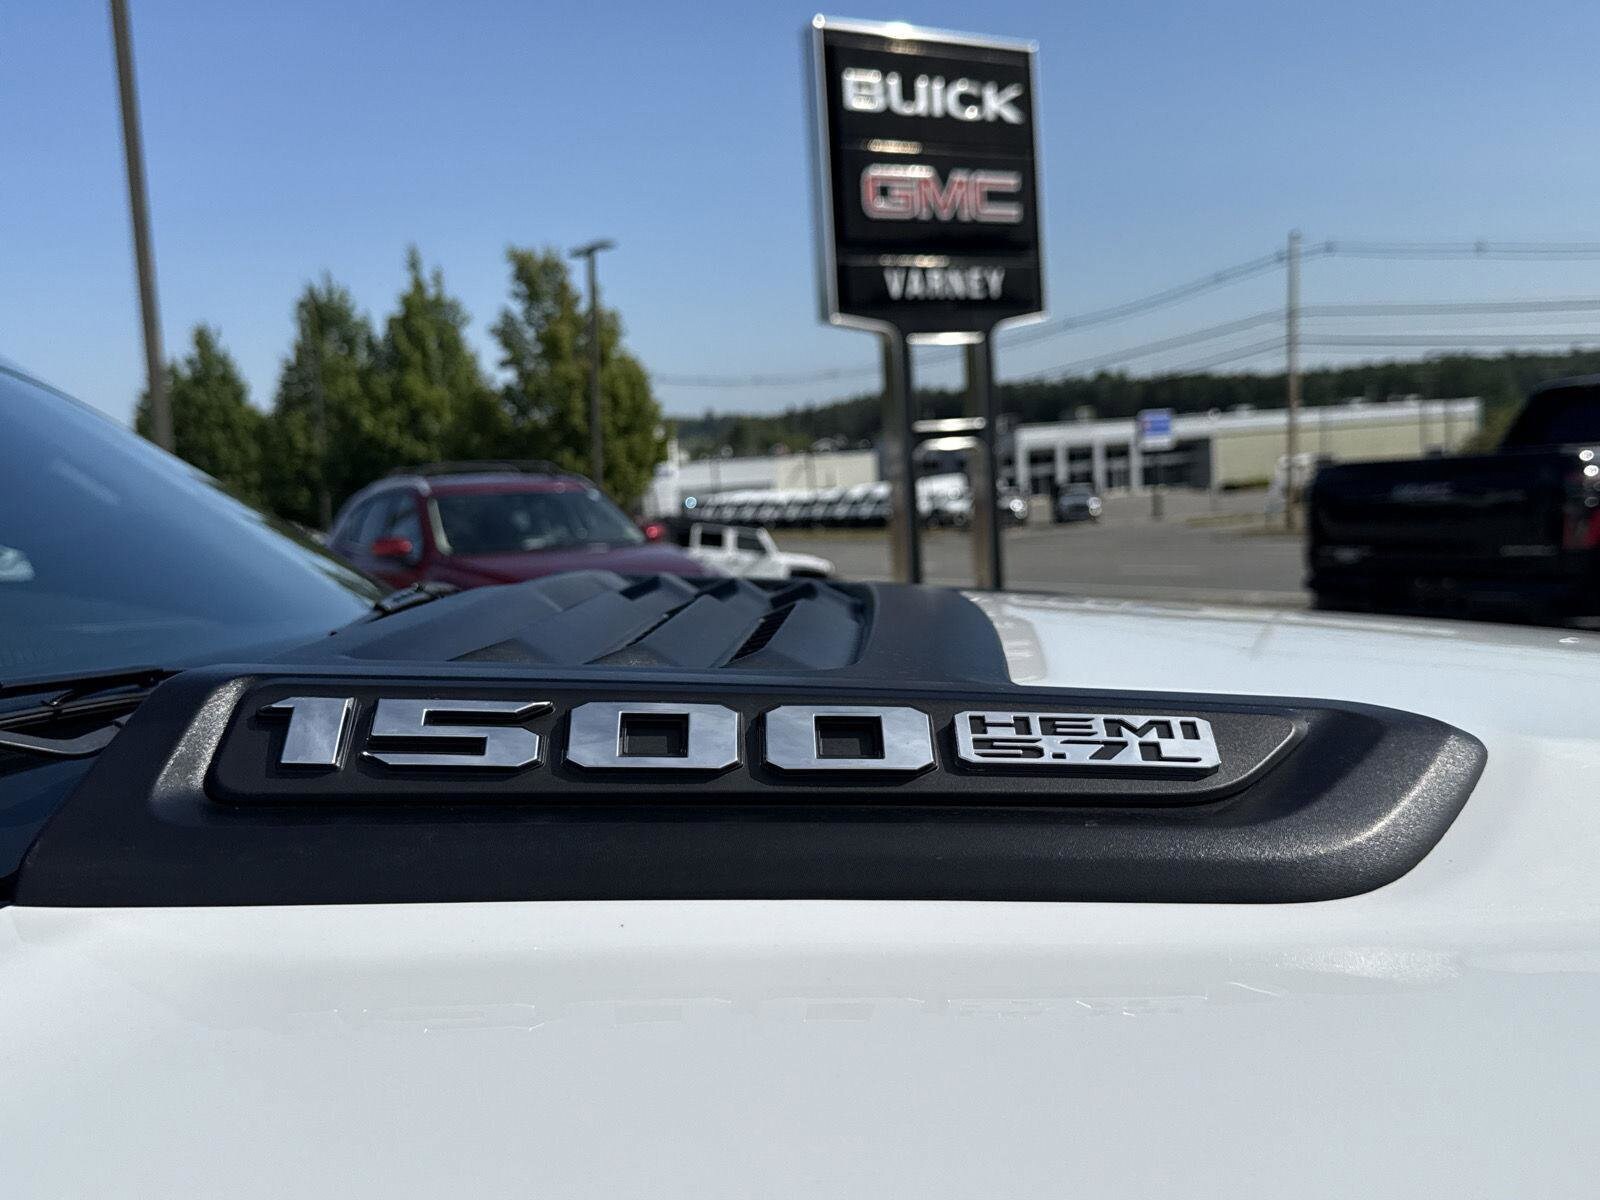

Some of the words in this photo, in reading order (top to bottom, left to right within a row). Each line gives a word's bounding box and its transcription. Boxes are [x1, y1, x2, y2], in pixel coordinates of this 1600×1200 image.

[841, 68, 1024, 124] BUICK
[860, 163, 1024, 223] GMC
[882, 266, 1006, 300] VARNEY
[258, 697, 936, 772] 1500
[968, 714, 1201, 740] HEMI
[972, 737, 1202, 763] 5.7L
